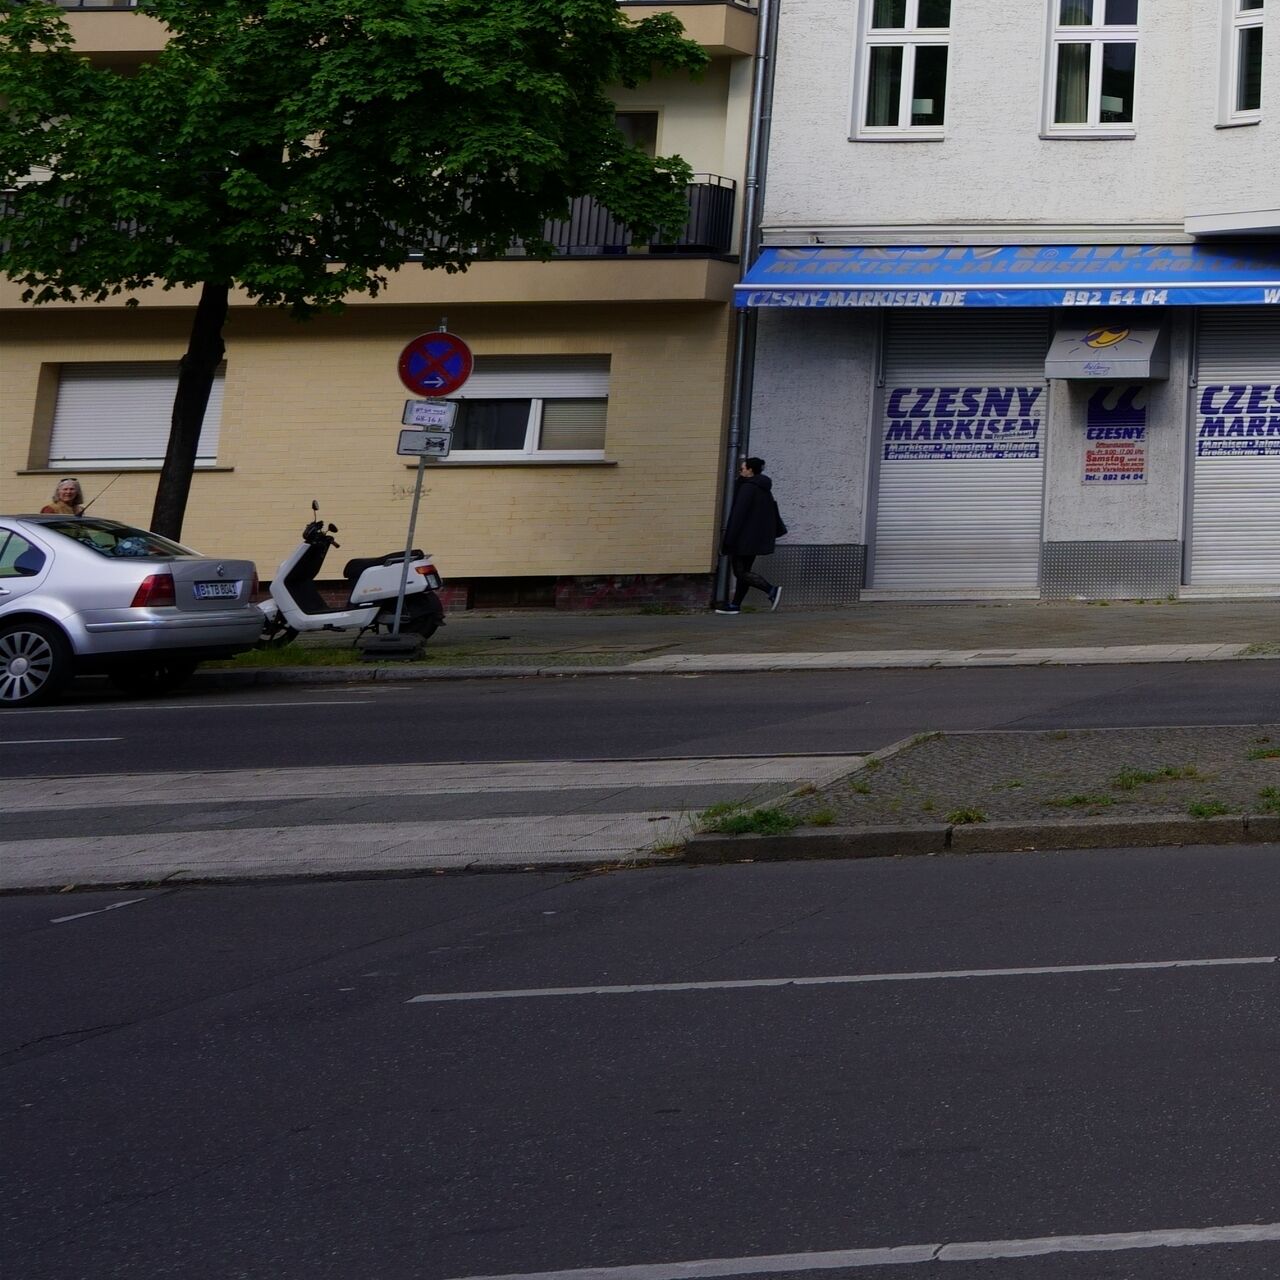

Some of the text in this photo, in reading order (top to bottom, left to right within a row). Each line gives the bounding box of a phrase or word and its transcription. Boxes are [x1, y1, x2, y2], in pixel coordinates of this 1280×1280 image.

[764, 261, 938, 273] MARKISEN
[747, 291, 966, 307] CZESNY-MARKISEN.DE
[1062, 289, 1168, 306] 892 64 04
[887, 387, 1042, 418] CZESNY
[885, 419, 1041, 440] MARKISEN
[1087, 428, 1145, 440] CZESNY
[1086, 455, 1125, 464] Samstag
